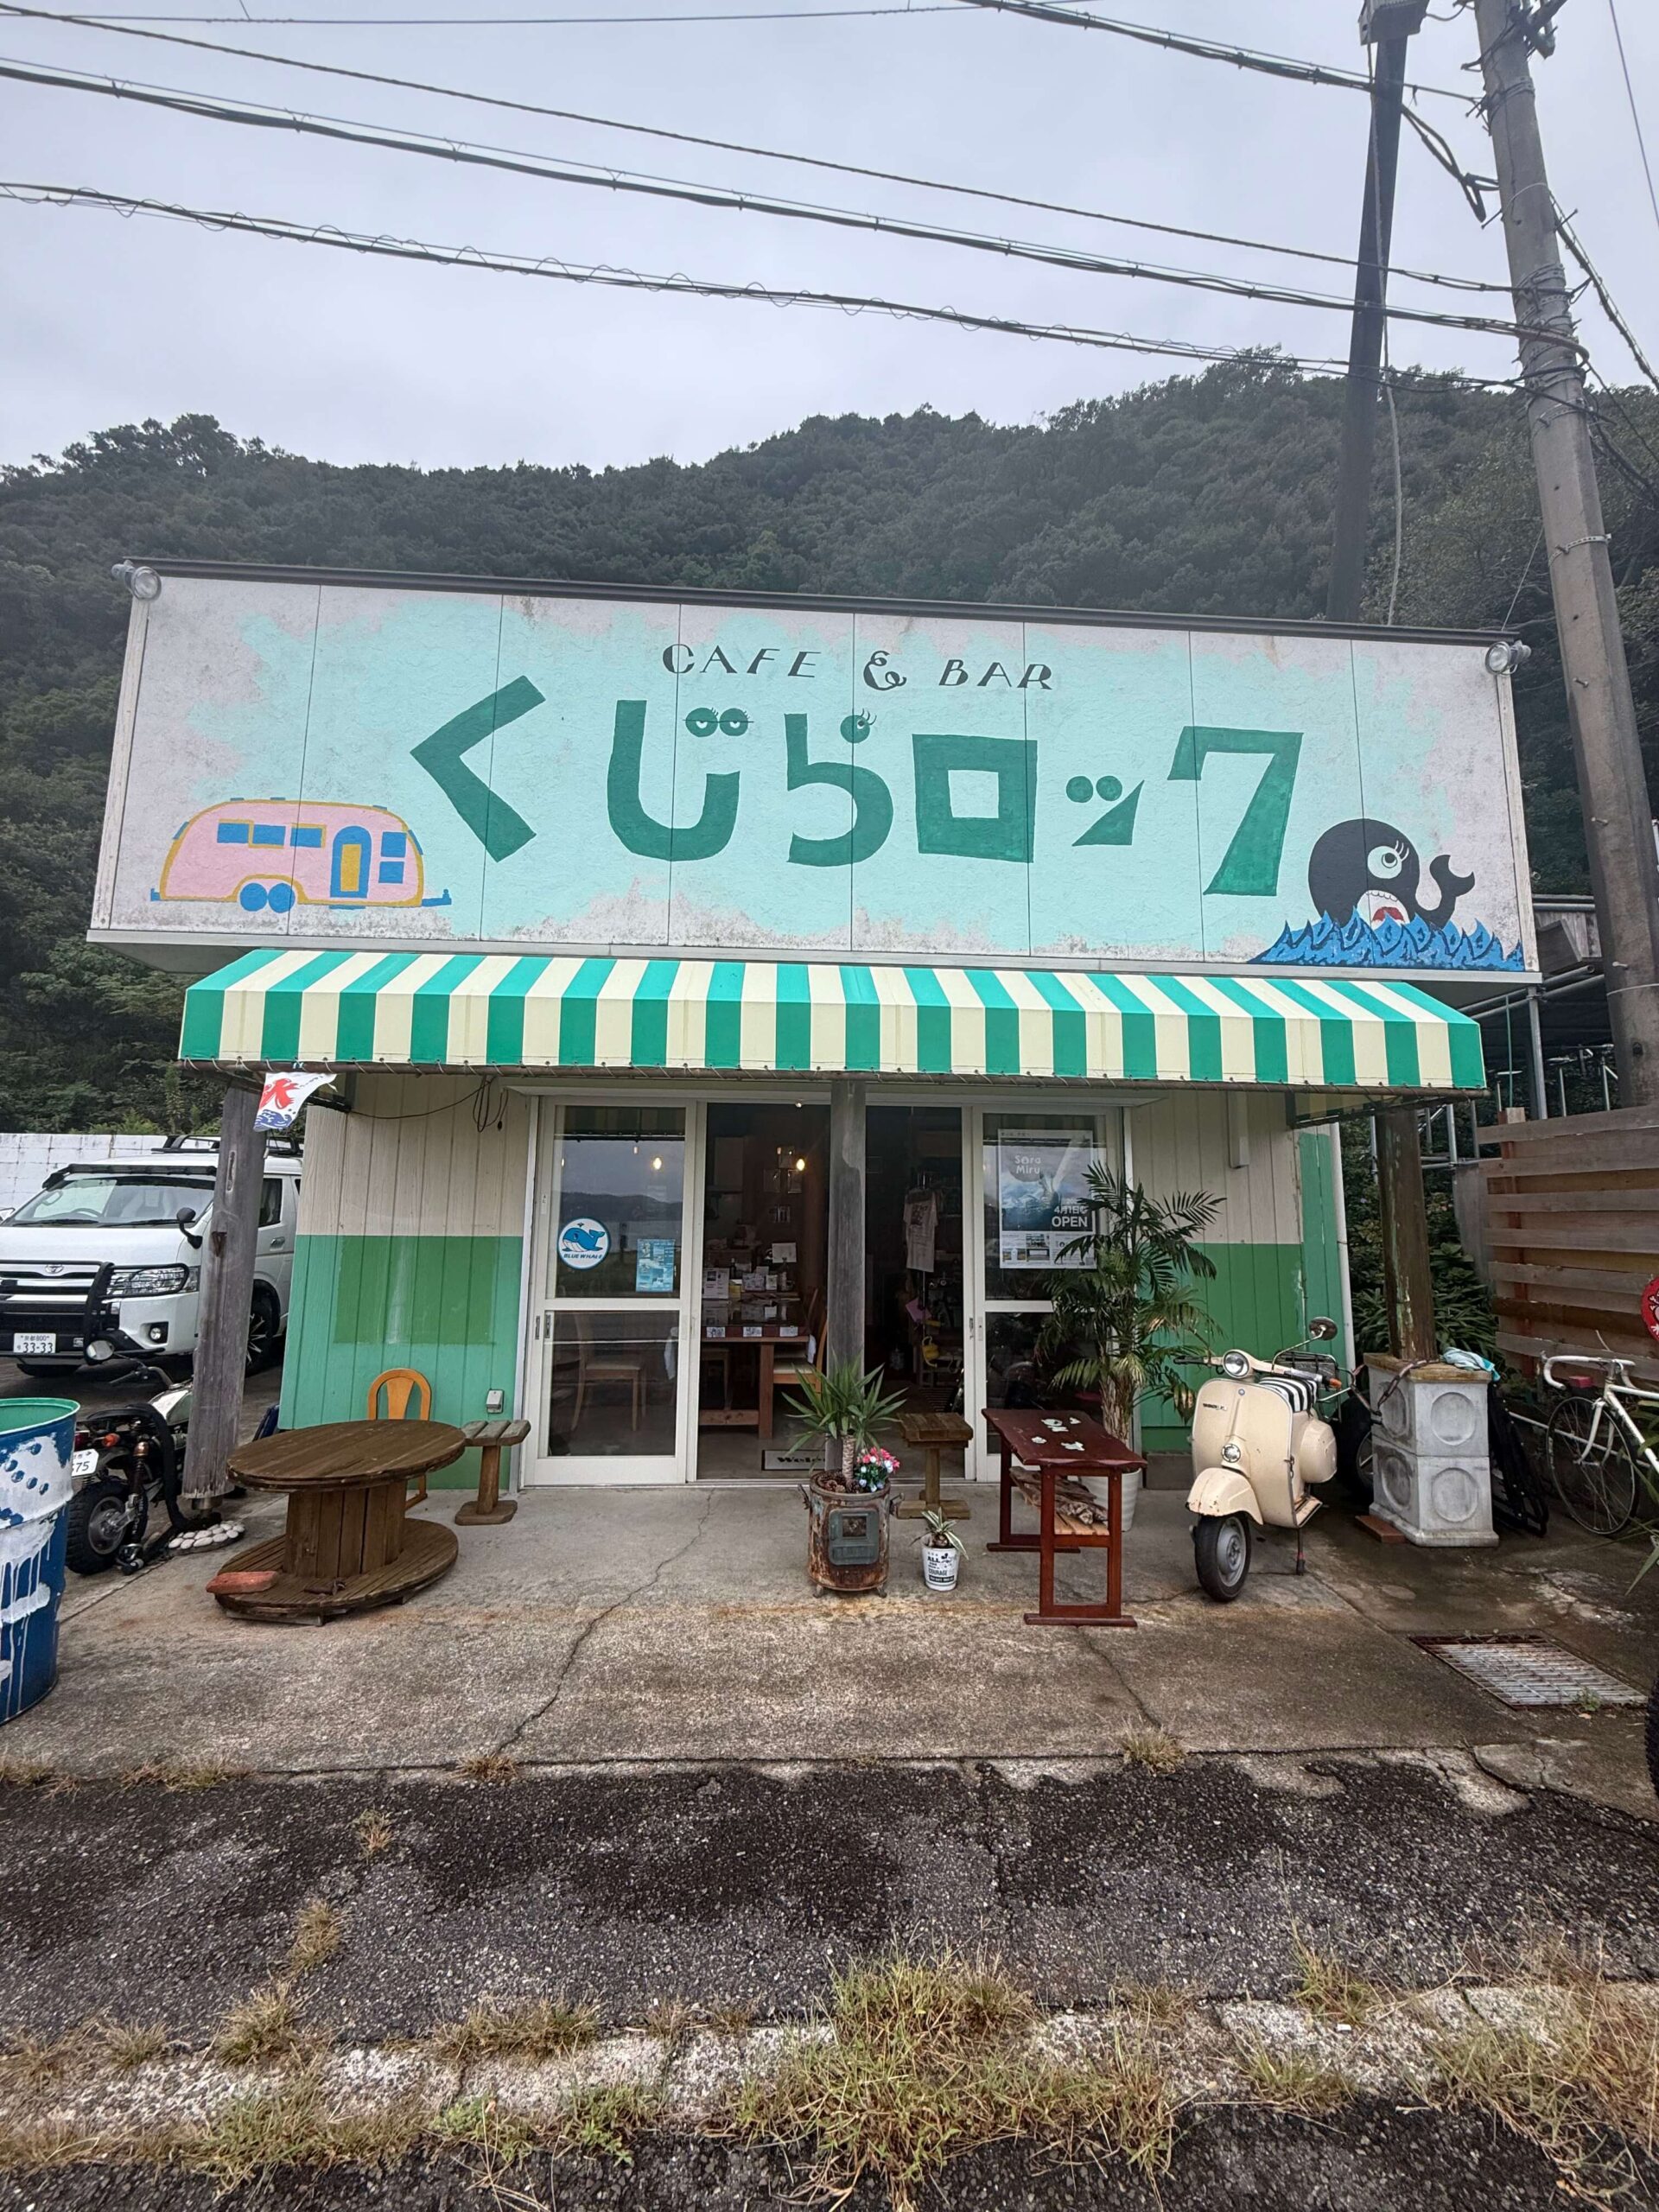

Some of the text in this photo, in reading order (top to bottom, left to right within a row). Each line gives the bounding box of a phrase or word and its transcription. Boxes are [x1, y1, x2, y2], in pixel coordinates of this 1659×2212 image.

[662, 643, 1053, 691] CAFE & BAR
[410, 676, 1304, 897] くじらロック
[1014, 1154, 1041, 1165] Sora
[1016, 1166, 1040, 1174] Miru
[1052, 1216, 1088, 1227] OPEN
[22, 1342, 53, 1353] 33-33
